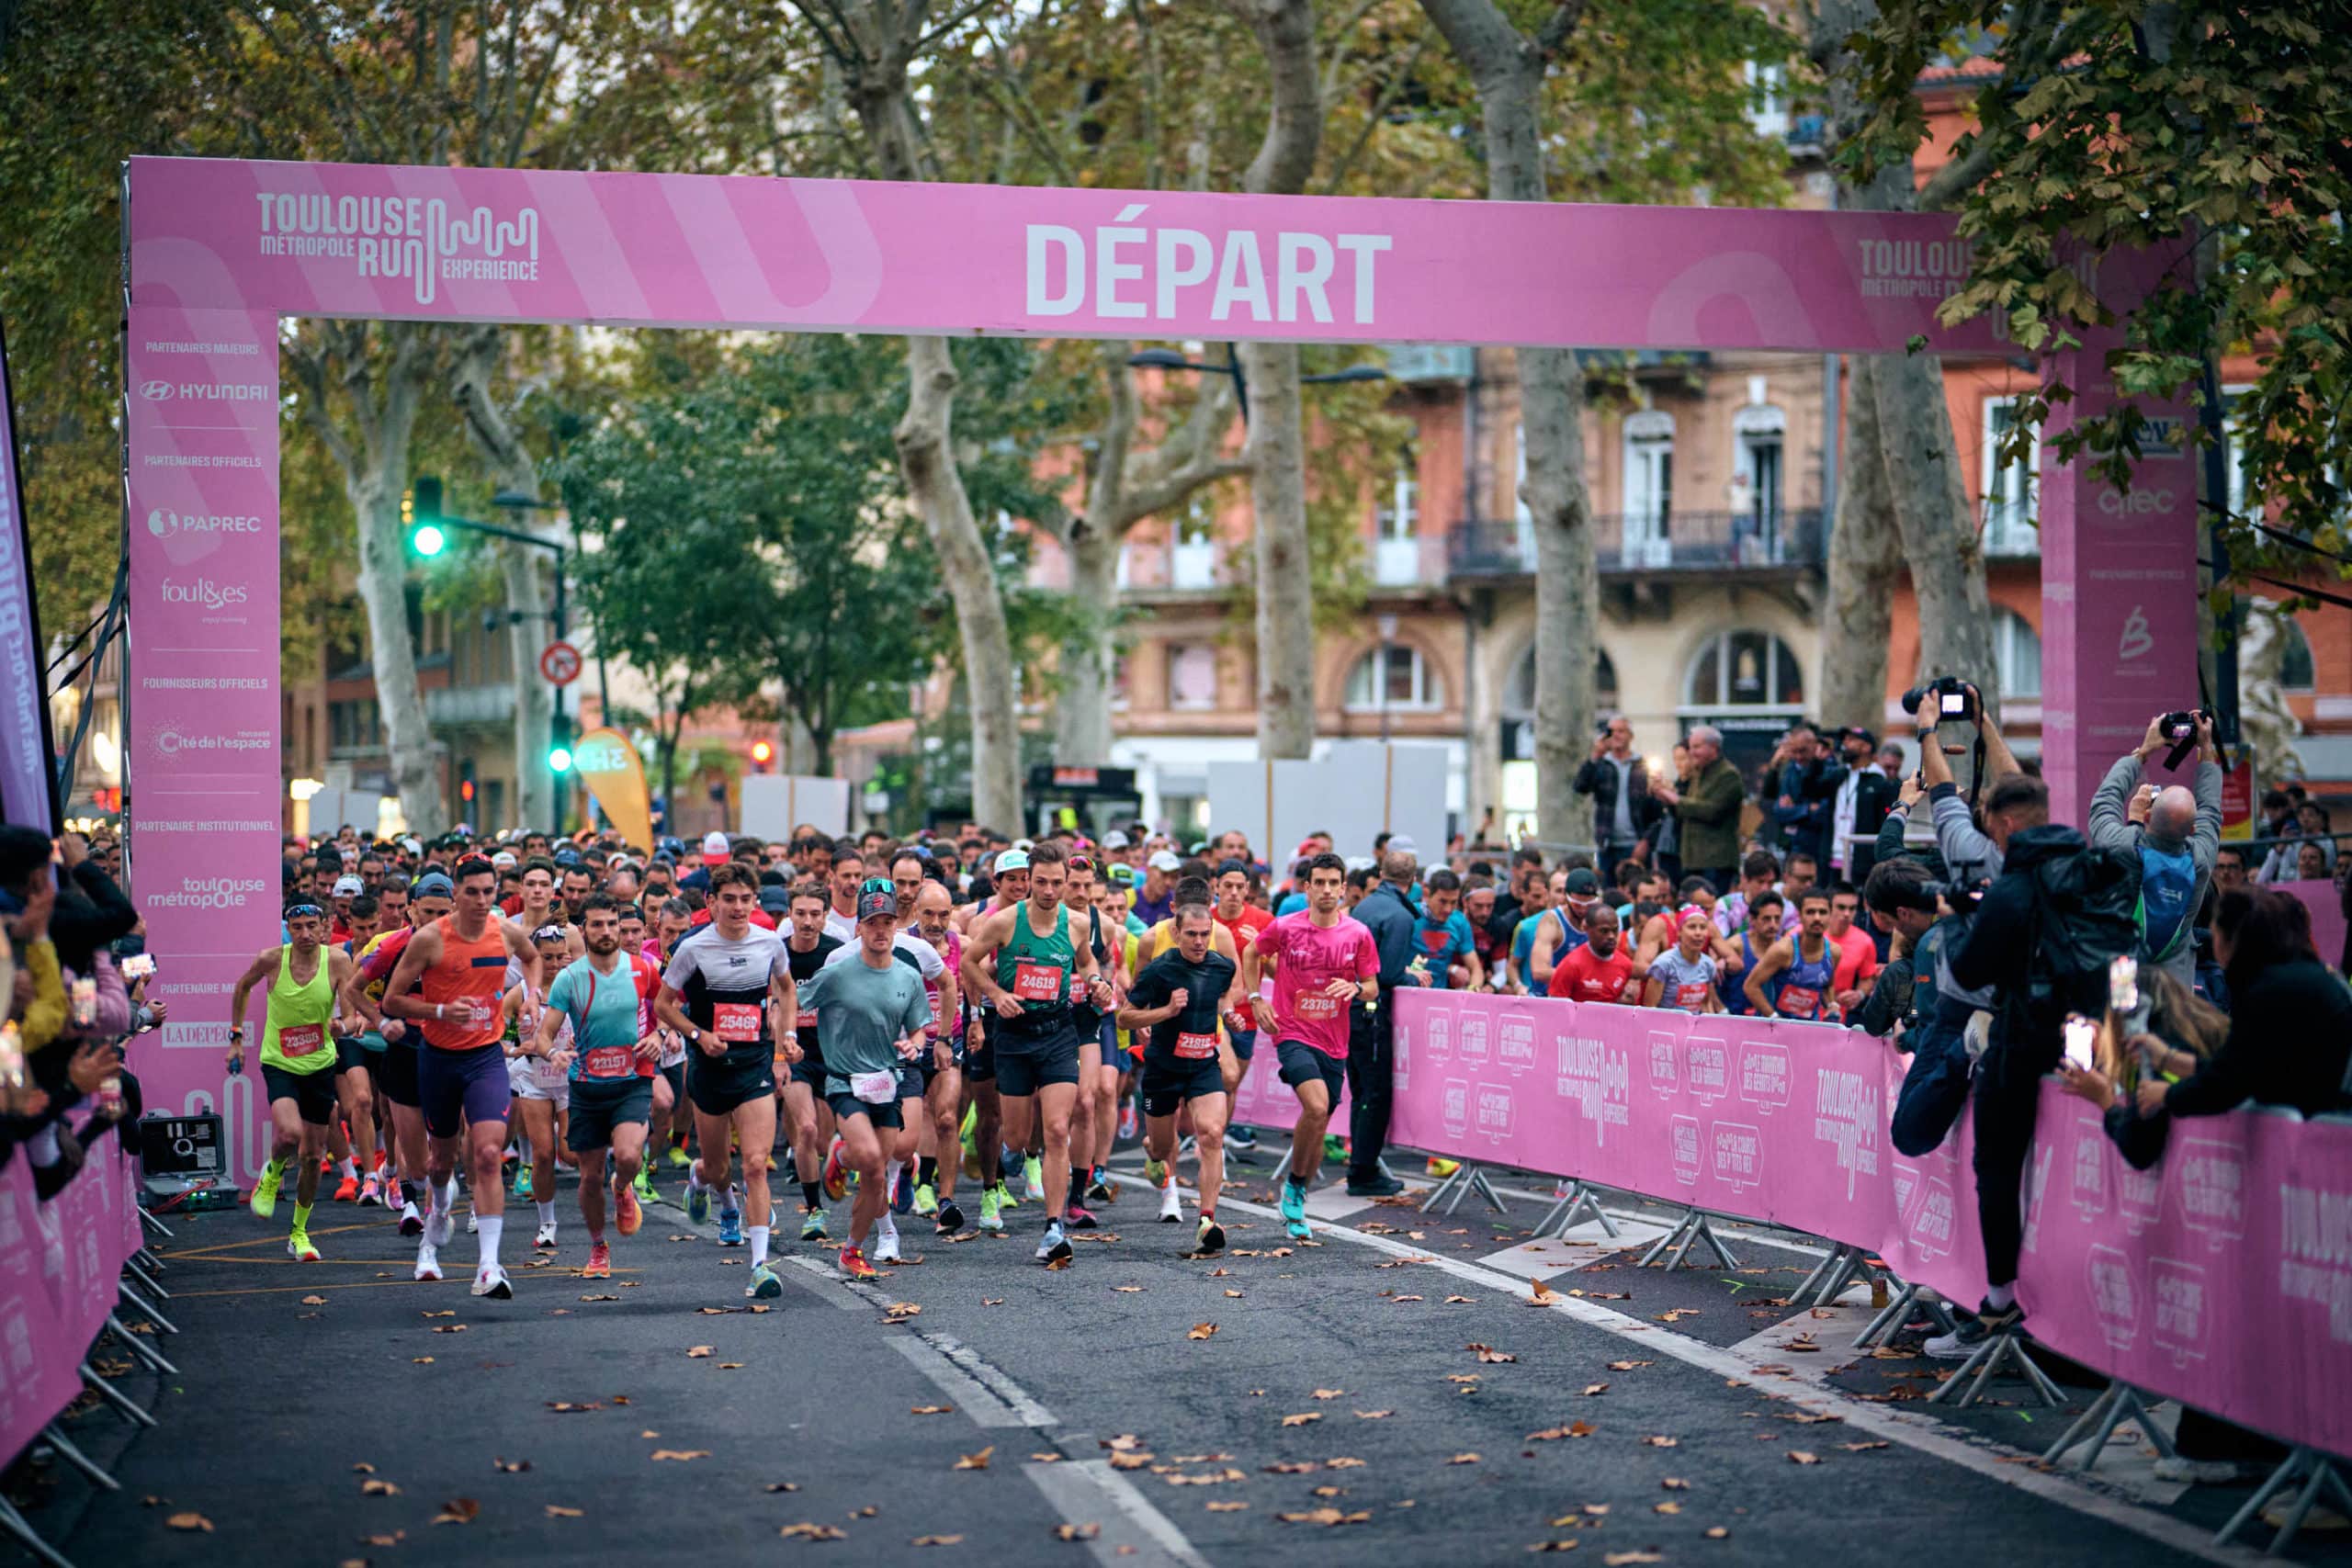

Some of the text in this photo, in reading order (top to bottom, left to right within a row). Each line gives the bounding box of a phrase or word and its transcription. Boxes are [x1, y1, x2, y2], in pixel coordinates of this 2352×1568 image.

[256, 193, 422, 236] TOULOUSE
[260, 232, 429, 287] MÉTROPOLE RUN
[1026, 204, 1392, 324] DÉPART
[1859, 240, 1973, 277] TOULOU
[442, 258, 538, 281] EXPERIENCE
[146, 342, 258, 355] PARTENAIRES MAJEURS
[179, 384, 268, 400] HYUNDAI
[144, 455, 262, 468] PARTENAIRES OFFICIELS
[183, 516, 261, 532] PAPREC
[143, 678, 268, 689] FOURNISSEURS OFFICIELS
[136, 821, 276, 831] PARTENAIRE INSTITUTIONNEL
[161, 984, 219, 994] PARTENAIRE
